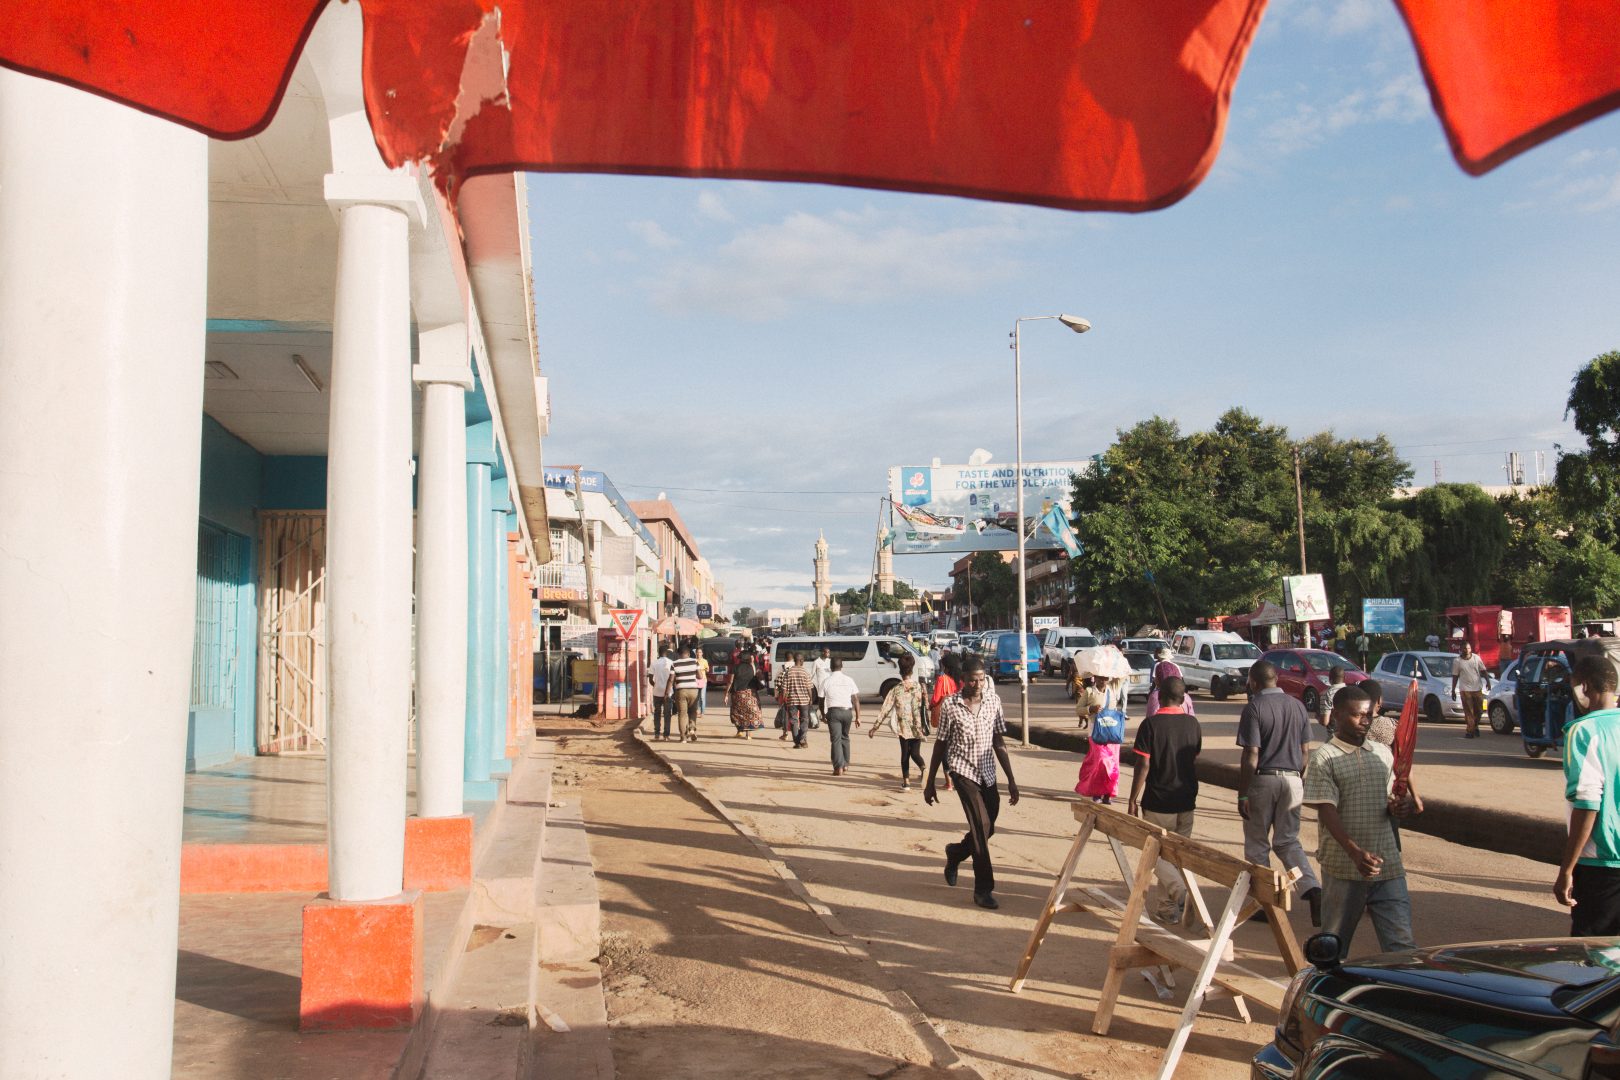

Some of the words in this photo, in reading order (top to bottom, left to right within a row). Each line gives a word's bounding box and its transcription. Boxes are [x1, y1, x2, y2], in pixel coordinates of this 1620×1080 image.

[958, 469, 990, 479] TASTE
[991, 468, 1014, 478] AND
[565, 475, 598, 486] ARADE
[955, 480, 976, 490] FOR
[978, 480, 1000, 489] THE
[543, 588, 574, 600] Bread
[576, 588, 600, 600] Tak
